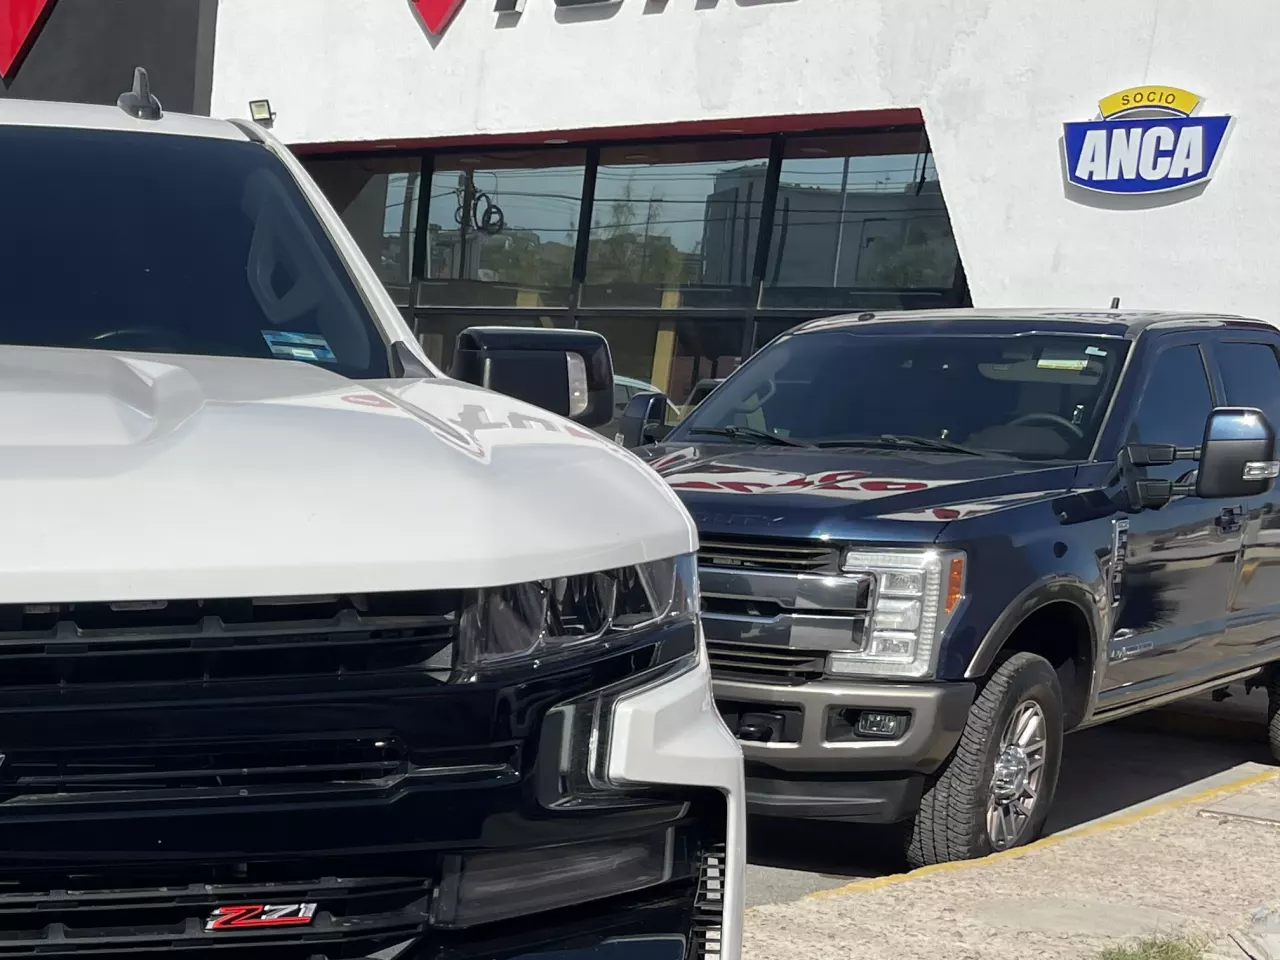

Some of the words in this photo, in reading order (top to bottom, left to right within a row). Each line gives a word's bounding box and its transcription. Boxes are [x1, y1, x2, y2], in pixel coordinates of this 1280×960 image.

[1121, 91, 1176, 105] SOCIO
[1075, 126, 1203, 180] ANCA
[205, 903, 318, 931] Z71
